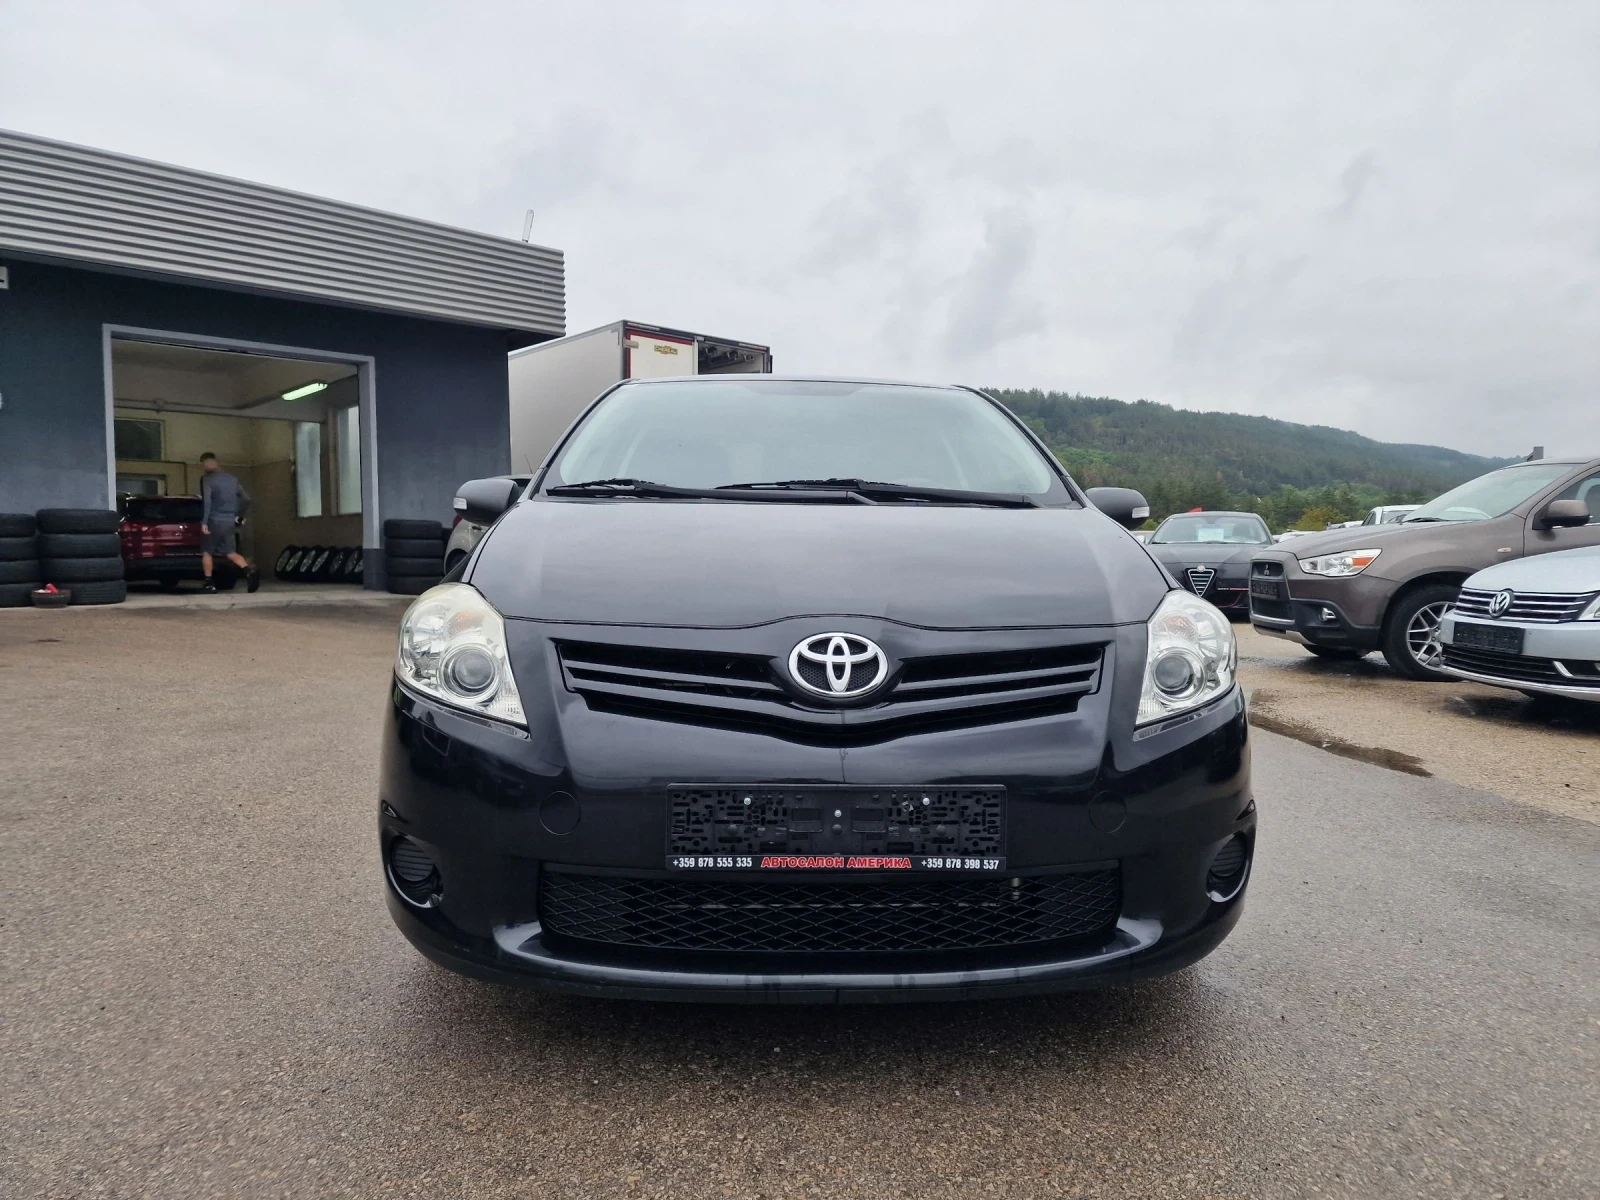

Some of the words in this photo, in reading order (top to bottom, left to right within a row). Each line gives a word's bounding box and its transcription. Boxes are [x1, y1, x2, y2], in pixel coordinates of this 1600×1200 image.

[673, 857, 695, 868] +359
[698, 857, 714, 868] 878
[716, 857, 733, 868] 555
[736, 857, 753, 868] 335
[761, 856, 844, 868] АВТОСАЛОН
[847, 857, 912, 869] АМЕРИКА
[921, 858, 943, 869] +359
[945, 858, 962, 869] 878
[964, 859, 981, 870] 398
[983, 859, 1000, 870] 537
